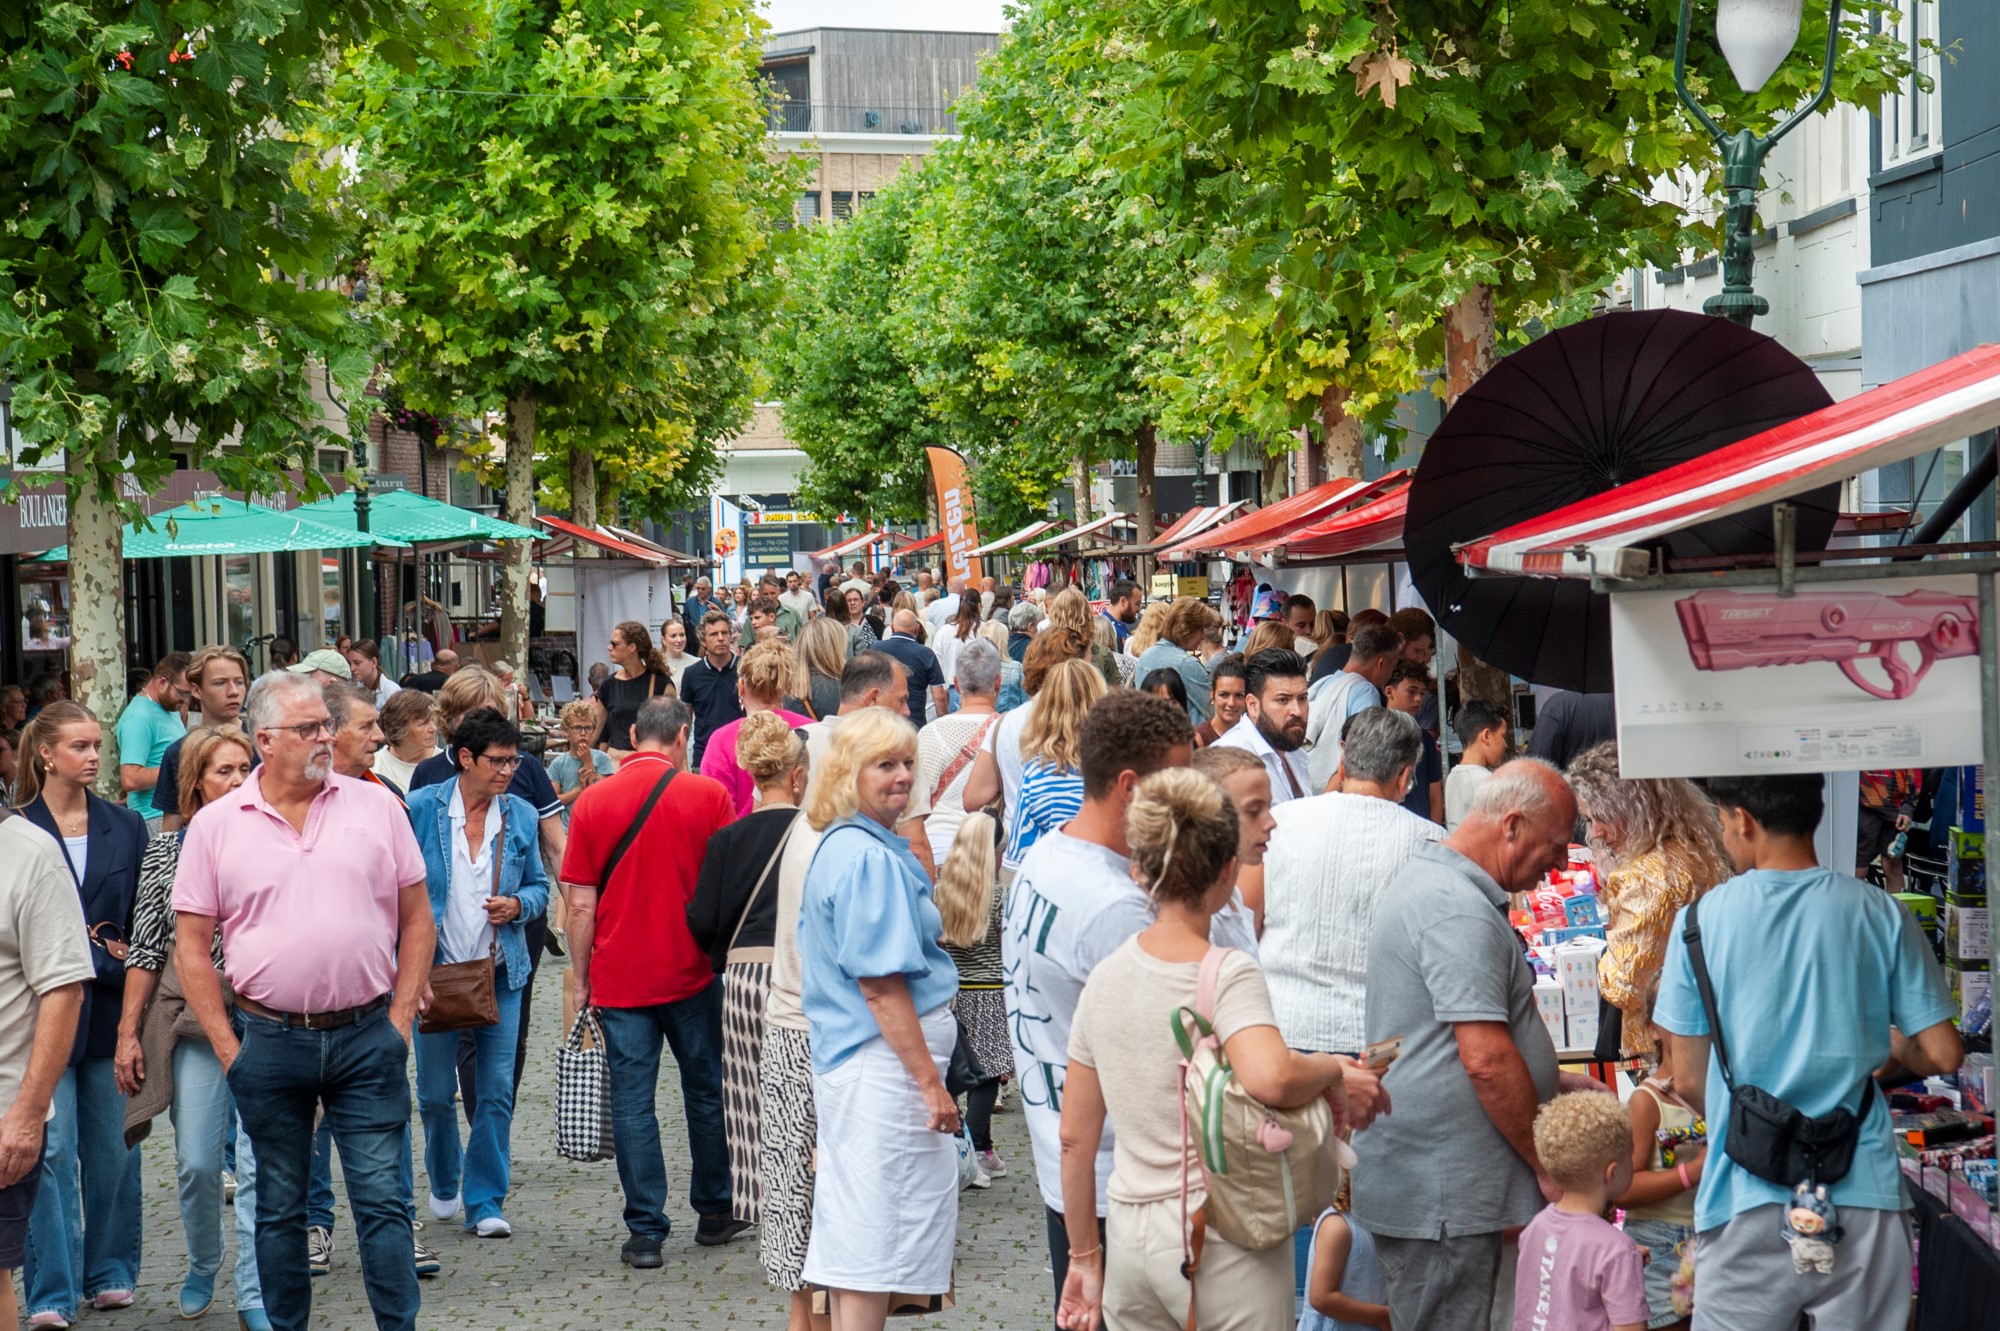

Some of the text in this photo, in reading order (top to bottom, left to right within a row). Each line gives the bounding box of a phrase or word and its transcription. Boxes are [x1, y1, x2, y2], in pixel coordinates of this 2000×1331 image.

[370, 479, 404, 488] turn
[764, 512, 793, 522] MINI
[1536, 1255, 1556, 1315] TAKE
